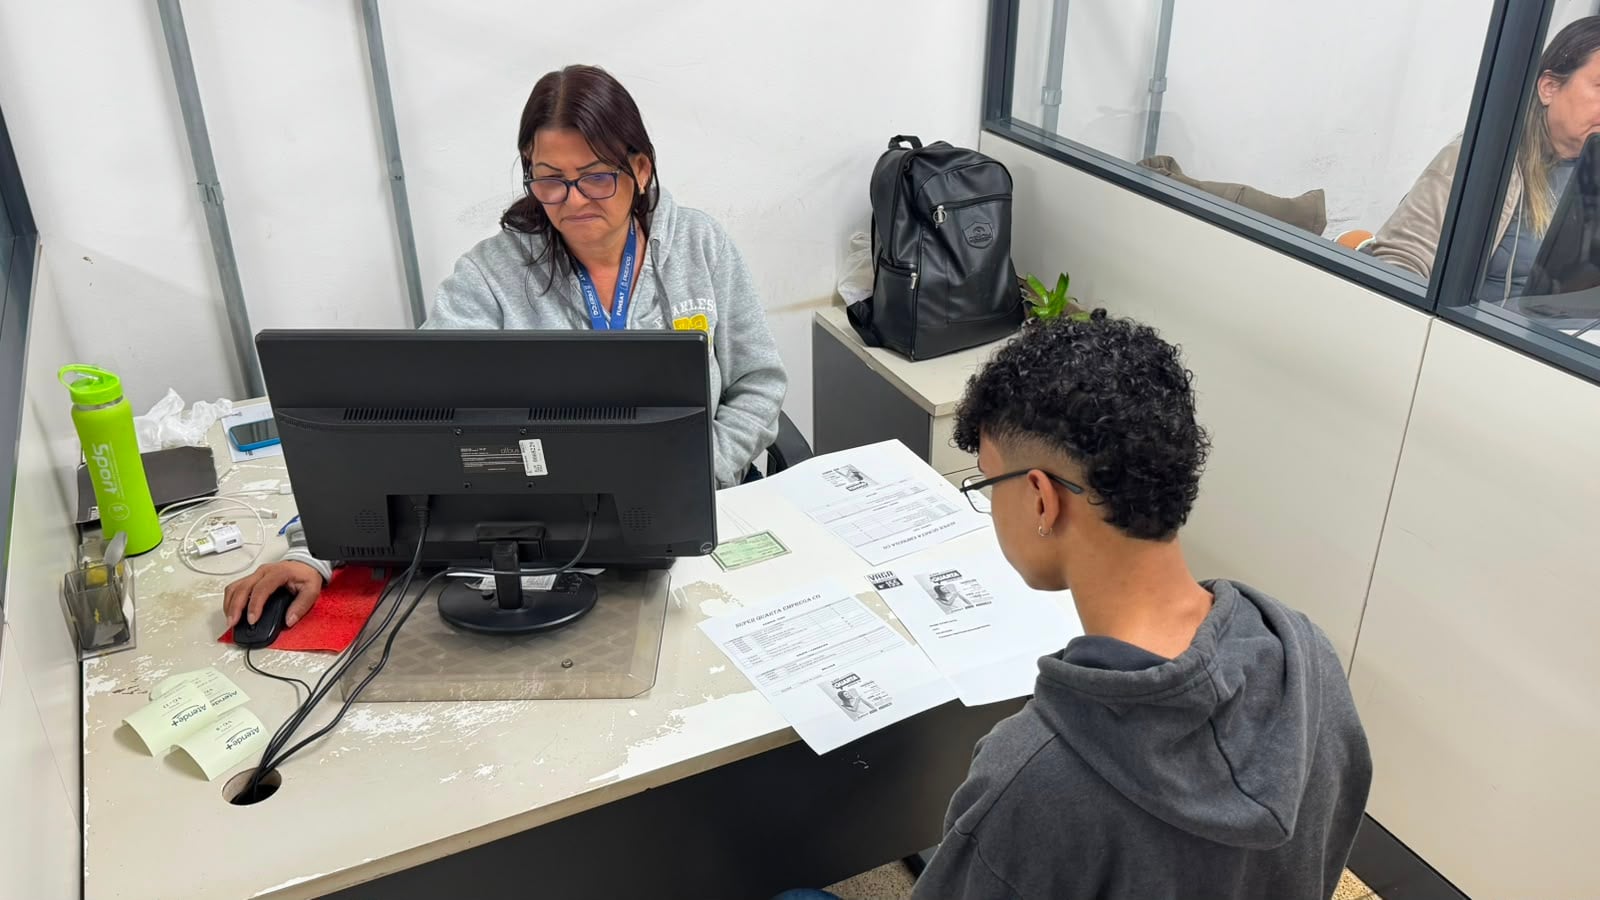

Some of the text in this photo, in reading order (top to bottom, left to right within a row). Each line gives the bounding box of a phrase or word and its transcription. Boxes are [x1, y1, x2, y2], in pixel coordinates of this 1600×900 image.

[92, 442, 118, 495] Sport
[211, 690, 238, 707] Atende
[171, 703, 207, 727] Atende+
[225, 726, 260, 751] Atende+
